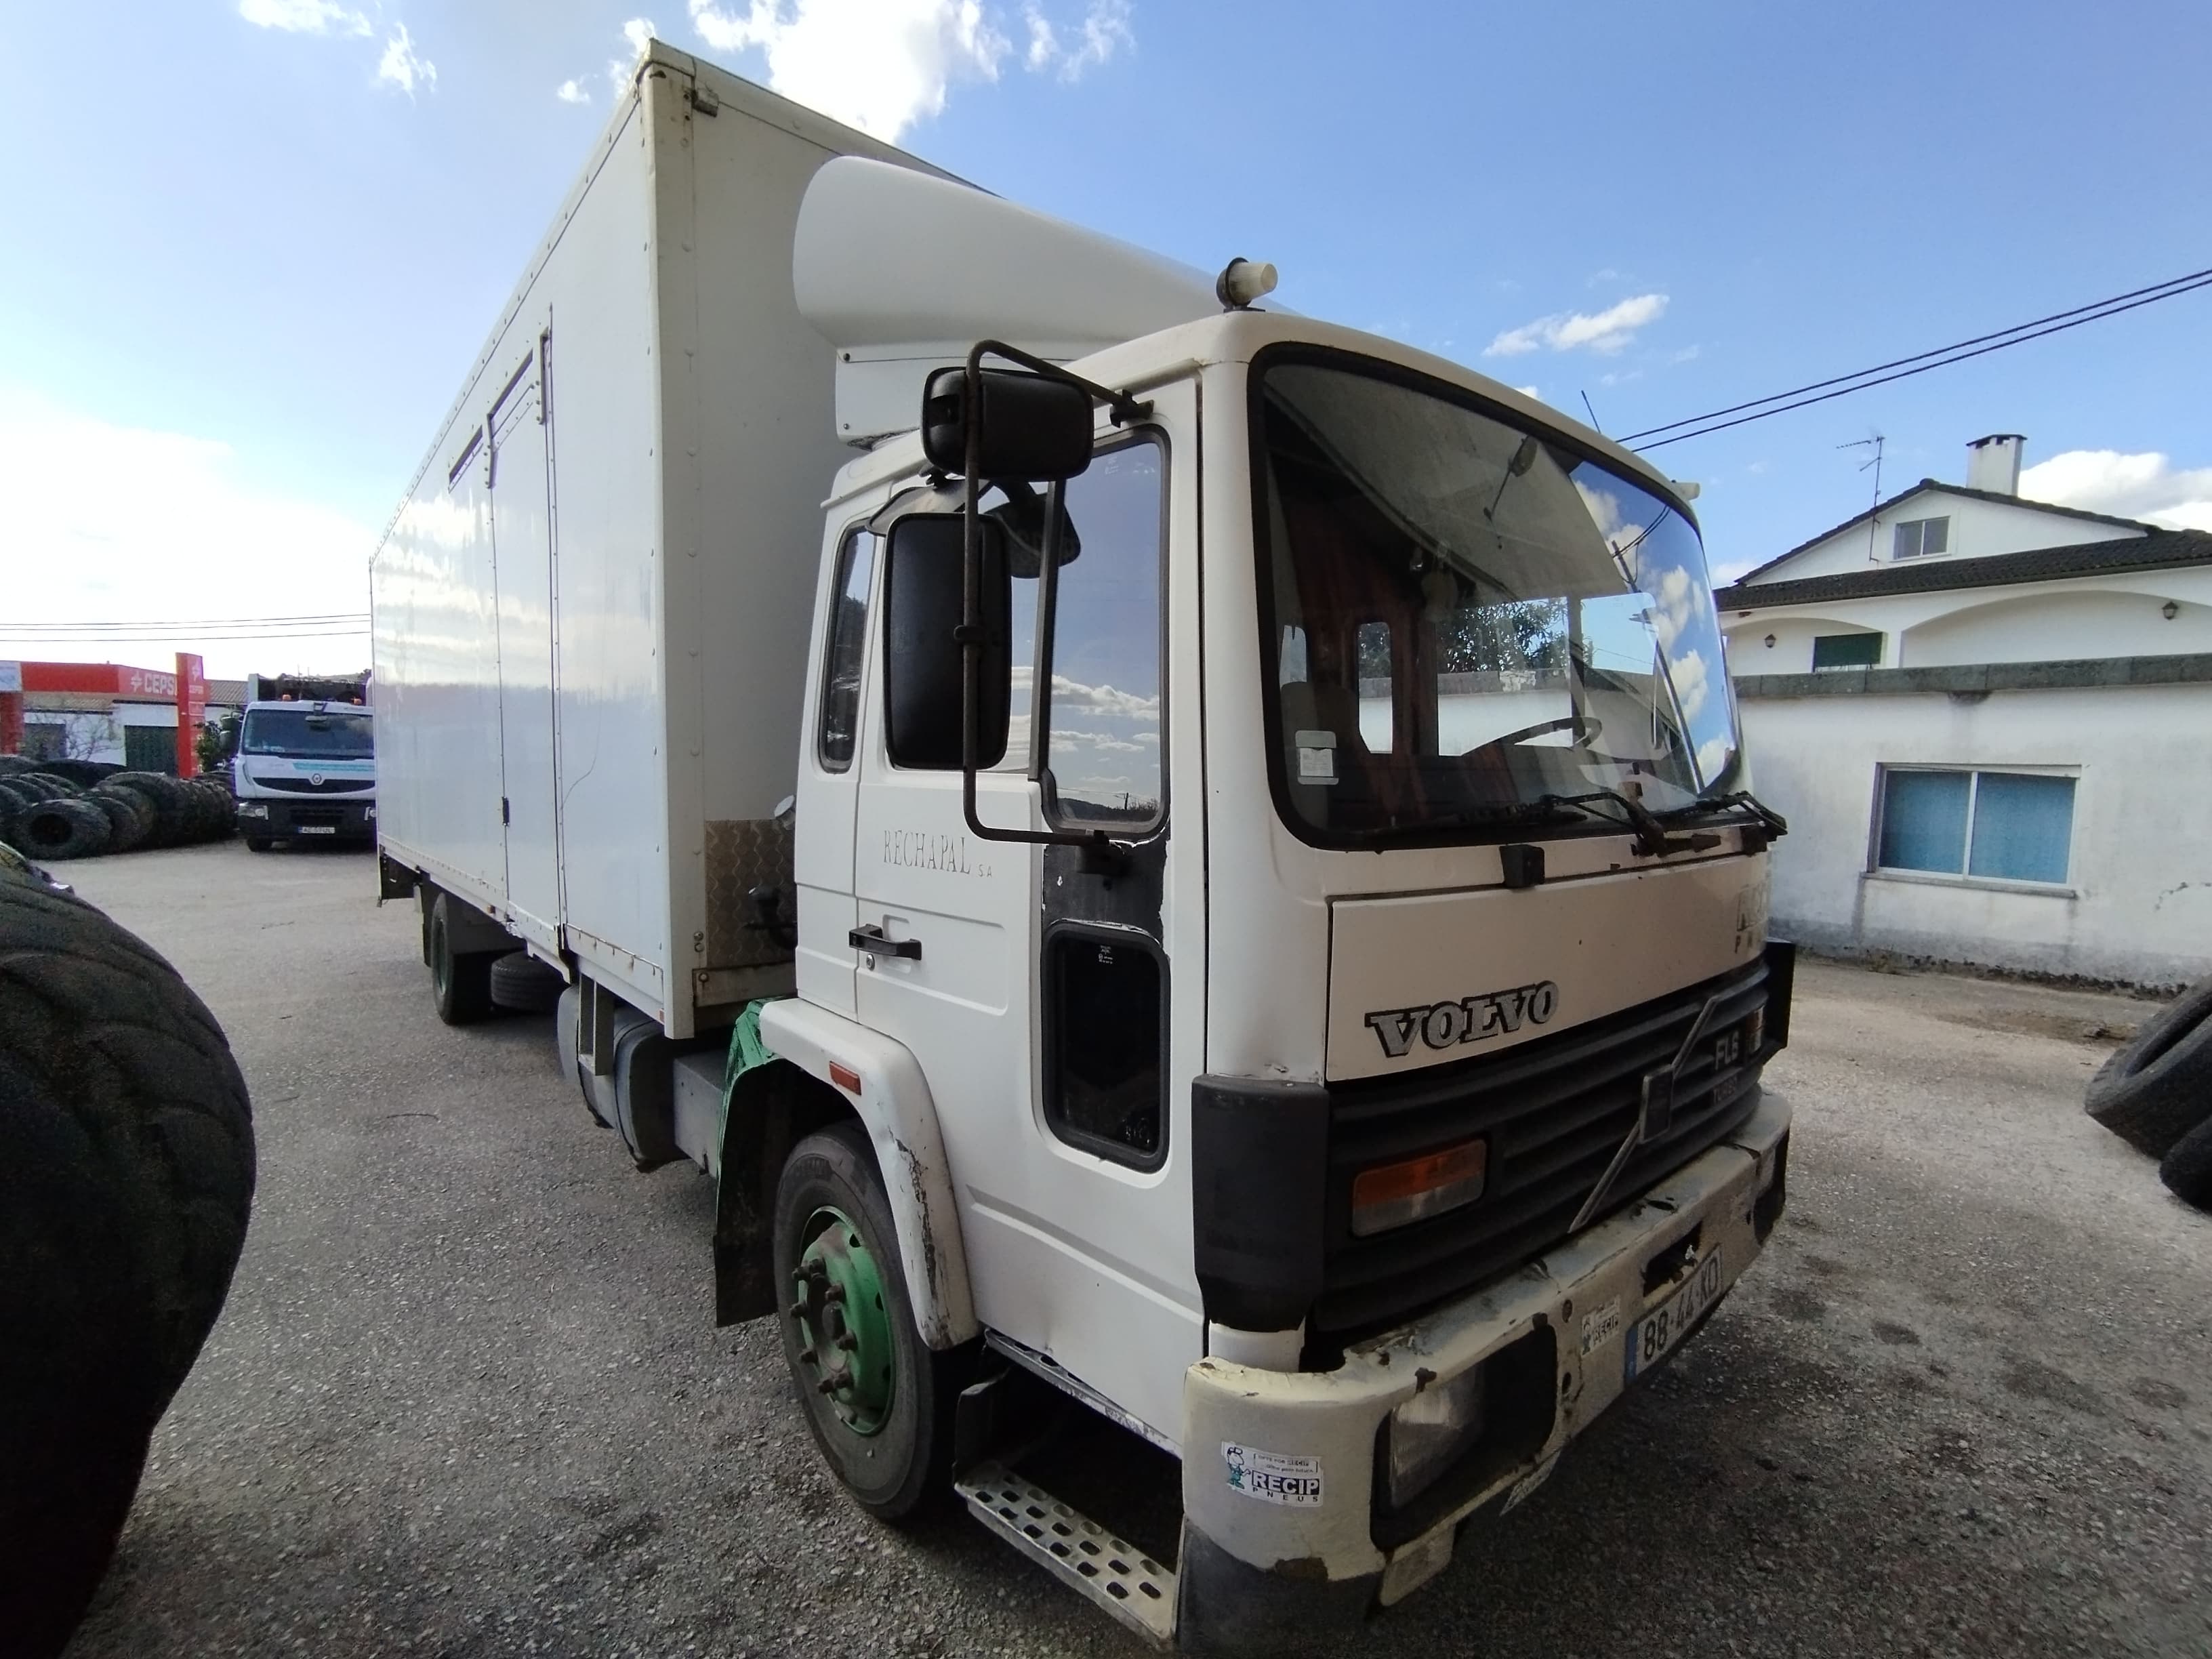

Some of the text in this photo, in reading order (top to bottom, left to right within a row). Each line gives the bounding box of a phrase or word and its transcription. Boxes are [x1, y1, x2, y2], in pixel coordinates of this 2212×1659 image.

[144, 672, 177, 696] CEPS
[884, 830, 971, 874] RECHAPAL
[1364, 980, 1559, 1058] VOLVO
[1715, 1030, 1739, 1070] FL6
[1252, 1471, 1319, 1494] RECIP
[1253, 1487, 1318, 1502] PNEUS
